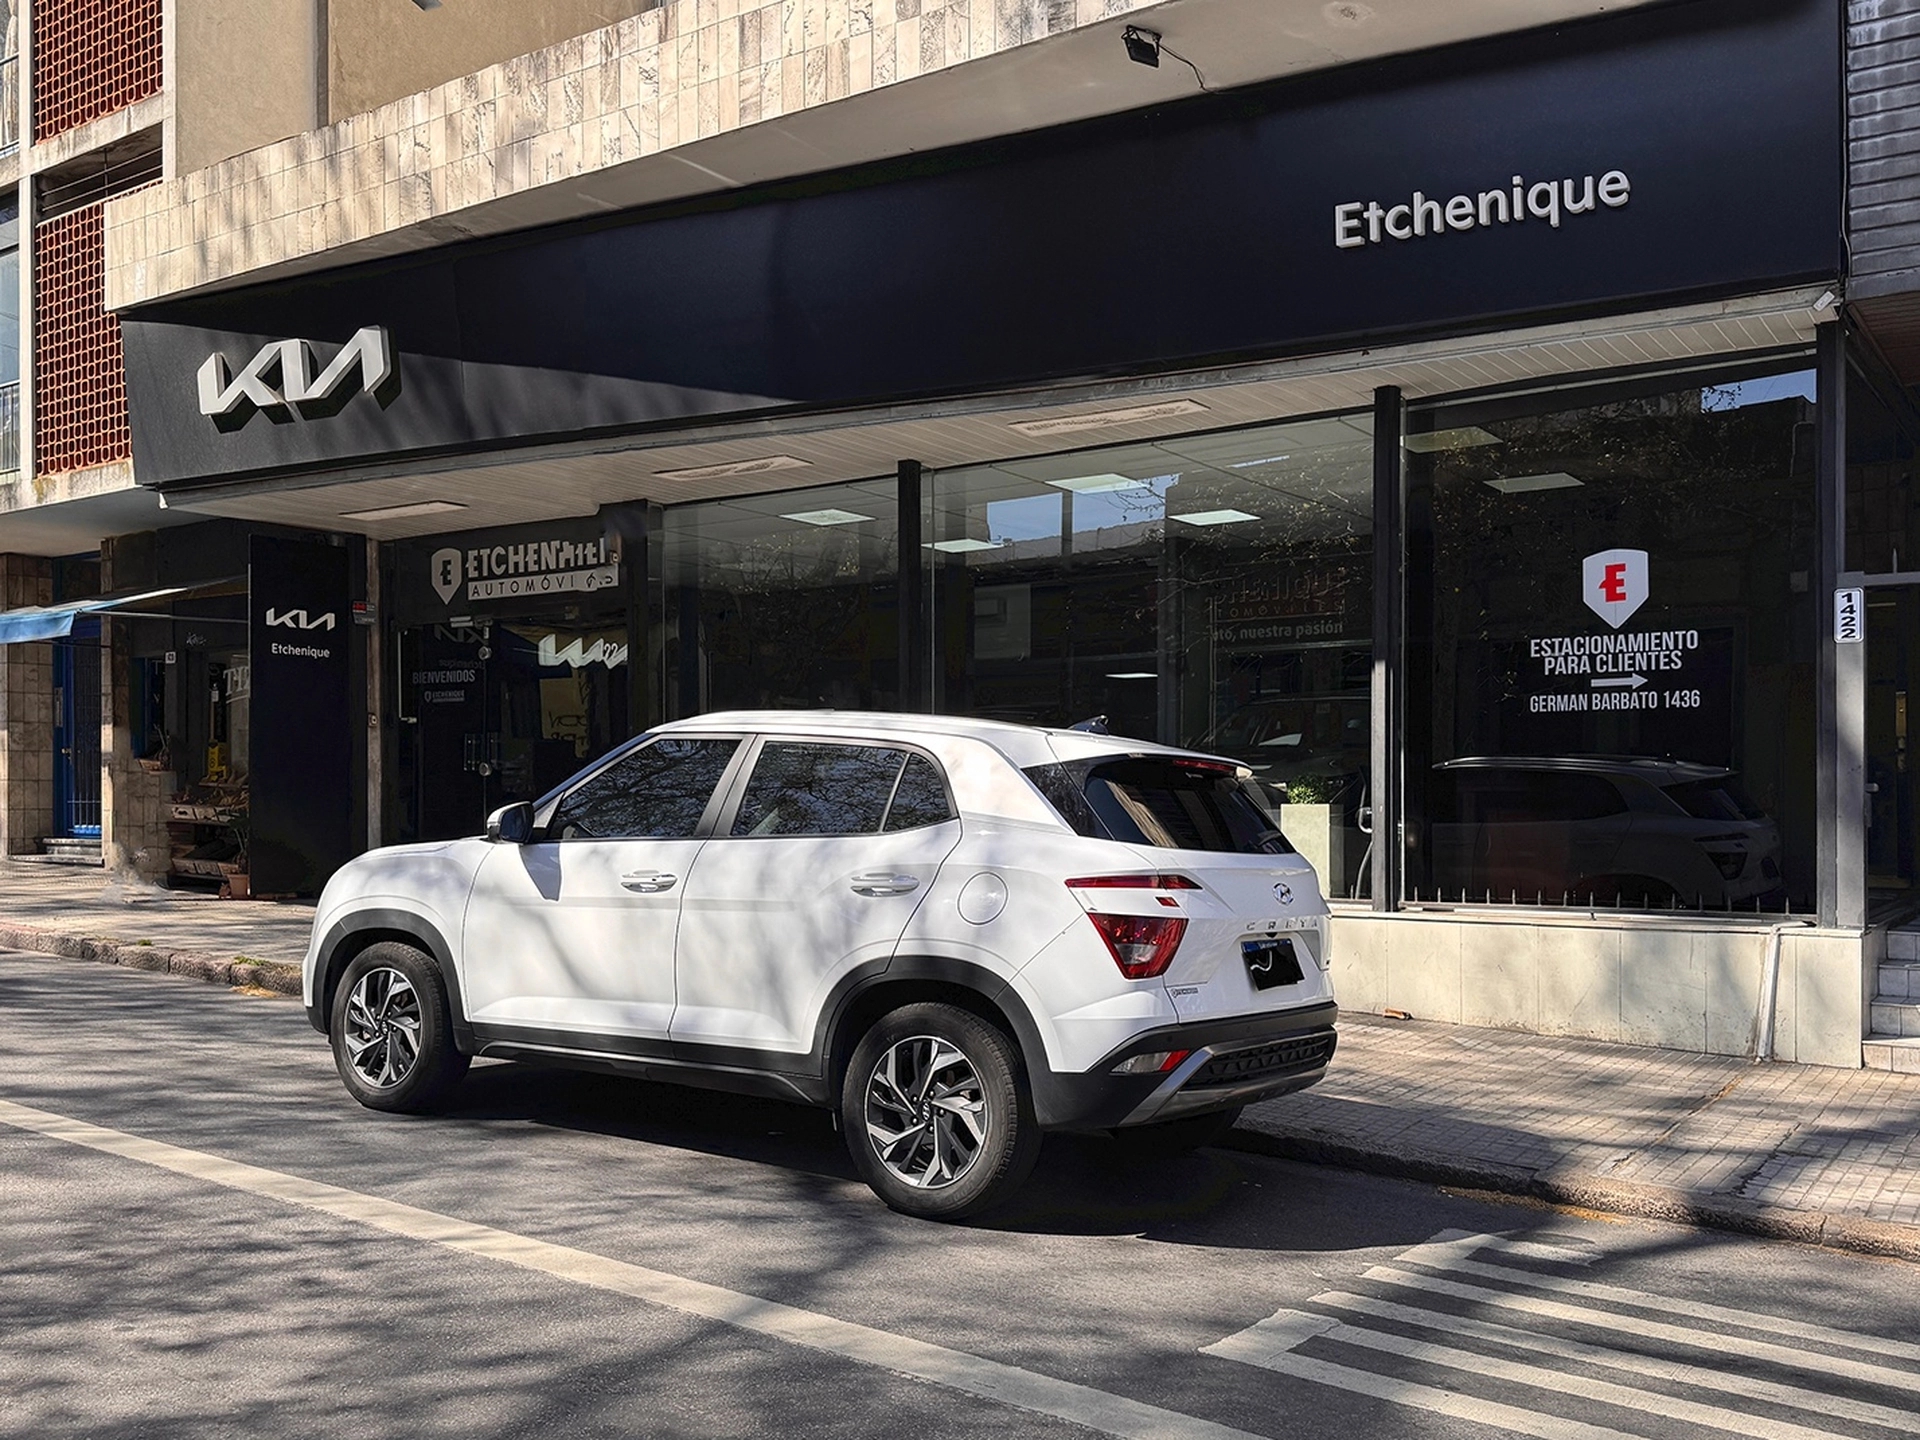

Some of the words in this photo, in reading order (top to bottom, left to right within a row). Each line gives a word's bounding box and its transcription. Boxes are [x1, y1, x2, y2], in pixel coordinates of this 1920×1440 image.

[1335, 169, 1631, 248] Etchenique
[197, 325, 391, 415] KIA
[266, 607, 335, 631] KIA
[1840, 592, 1856, 639] 1422
[1240, 624, 1292, 639] nuestra
[1296, 620, 1343, 638] pasión
[272, 643, 330, 659] Etchenique
[1530, 629, 1699, 658] ESTACIONAMIENTO
[1544, 655, 1591, 675] PARA
[1596, 650, 1682, 673] CLIENTES
[412, 669, 476, 684] BIENVENIDOS
[1530, 693, 1588, 713] GERMAN
[1592, 691, 1658, 711] BARBATO
[1663, 689, 1701, 708] 1436
